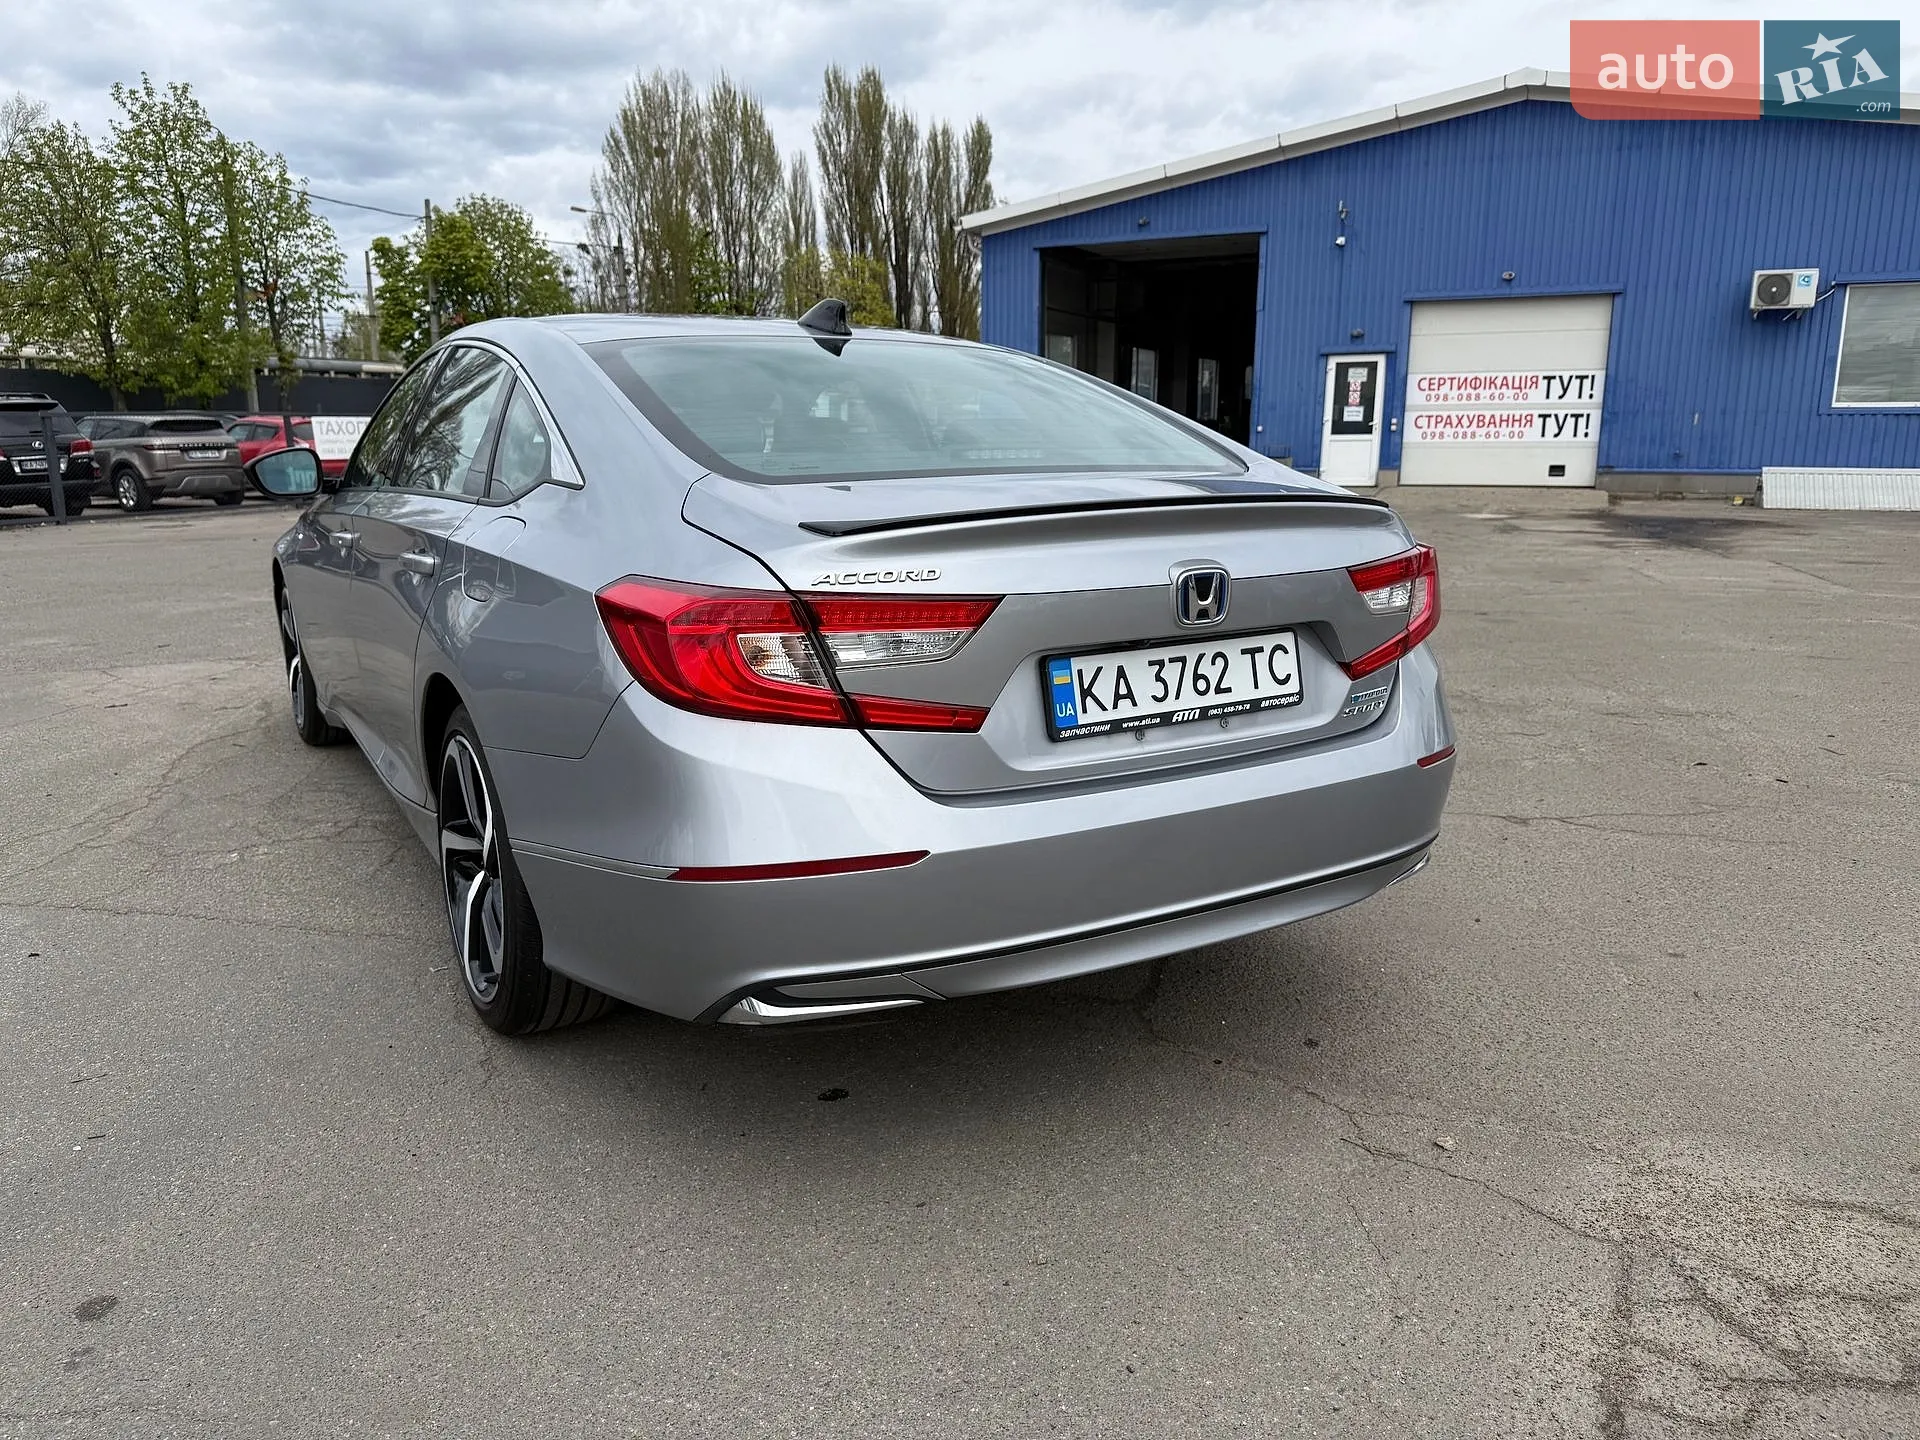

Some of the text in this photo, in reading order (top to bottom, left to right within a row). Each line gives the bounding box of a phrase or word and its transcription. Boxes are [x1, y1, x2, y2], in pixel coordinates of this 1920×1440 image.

[1417, 375, 1596, 400] СЕРТИФІКАЦІЯ ТУТ!
[1425, 392, 1529, 402] 098-088-60-00
[1414, 413, 1591, 438] СТРАХУВАННЯ ТУТ!
[1421, 430, 1525, 440] 098-088-60-00
[811, 568, 943, 586] ACCORD
[1077, 643, 1292, 714] KA 3762 TC
[1056, 703, 1075, 718] UA
[1060, 724, 1111, 738] запчастини
